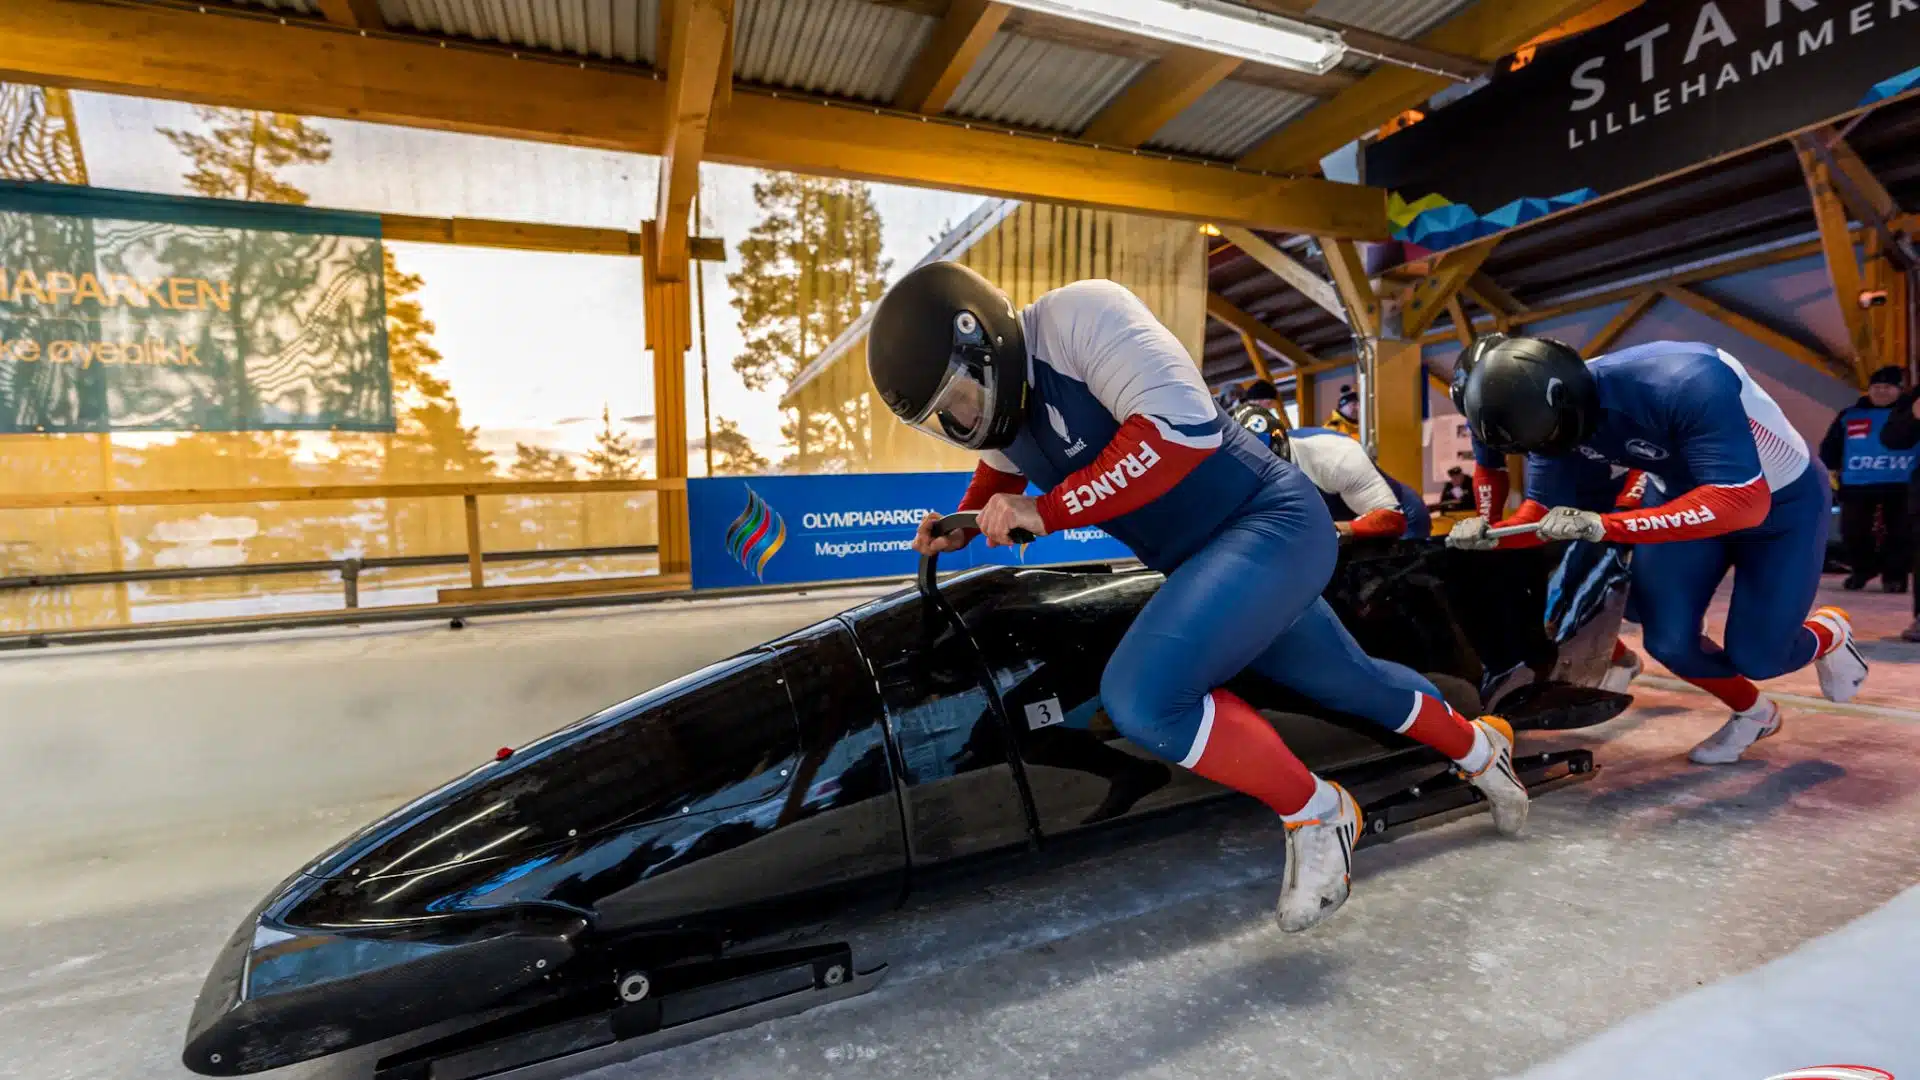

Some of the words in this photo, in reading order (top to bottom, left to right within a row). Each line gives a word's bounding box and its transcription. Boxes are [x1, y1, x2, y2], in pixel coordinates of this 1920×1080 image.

[1568, 0, 1920, 149] LILLEHAMMER
[47, 334, 201, 370] øyeblikk
[1064, 437, 1088, 458] FRANCE
[1848, 455, 1914, 470] CREW
[1062, 440, 1161, 515] FRANCE
[1624, 505, 1716, 532] FRANCE
[815, 541, 867, 557] Magical
[1037, 703, 1052, 725] 3
